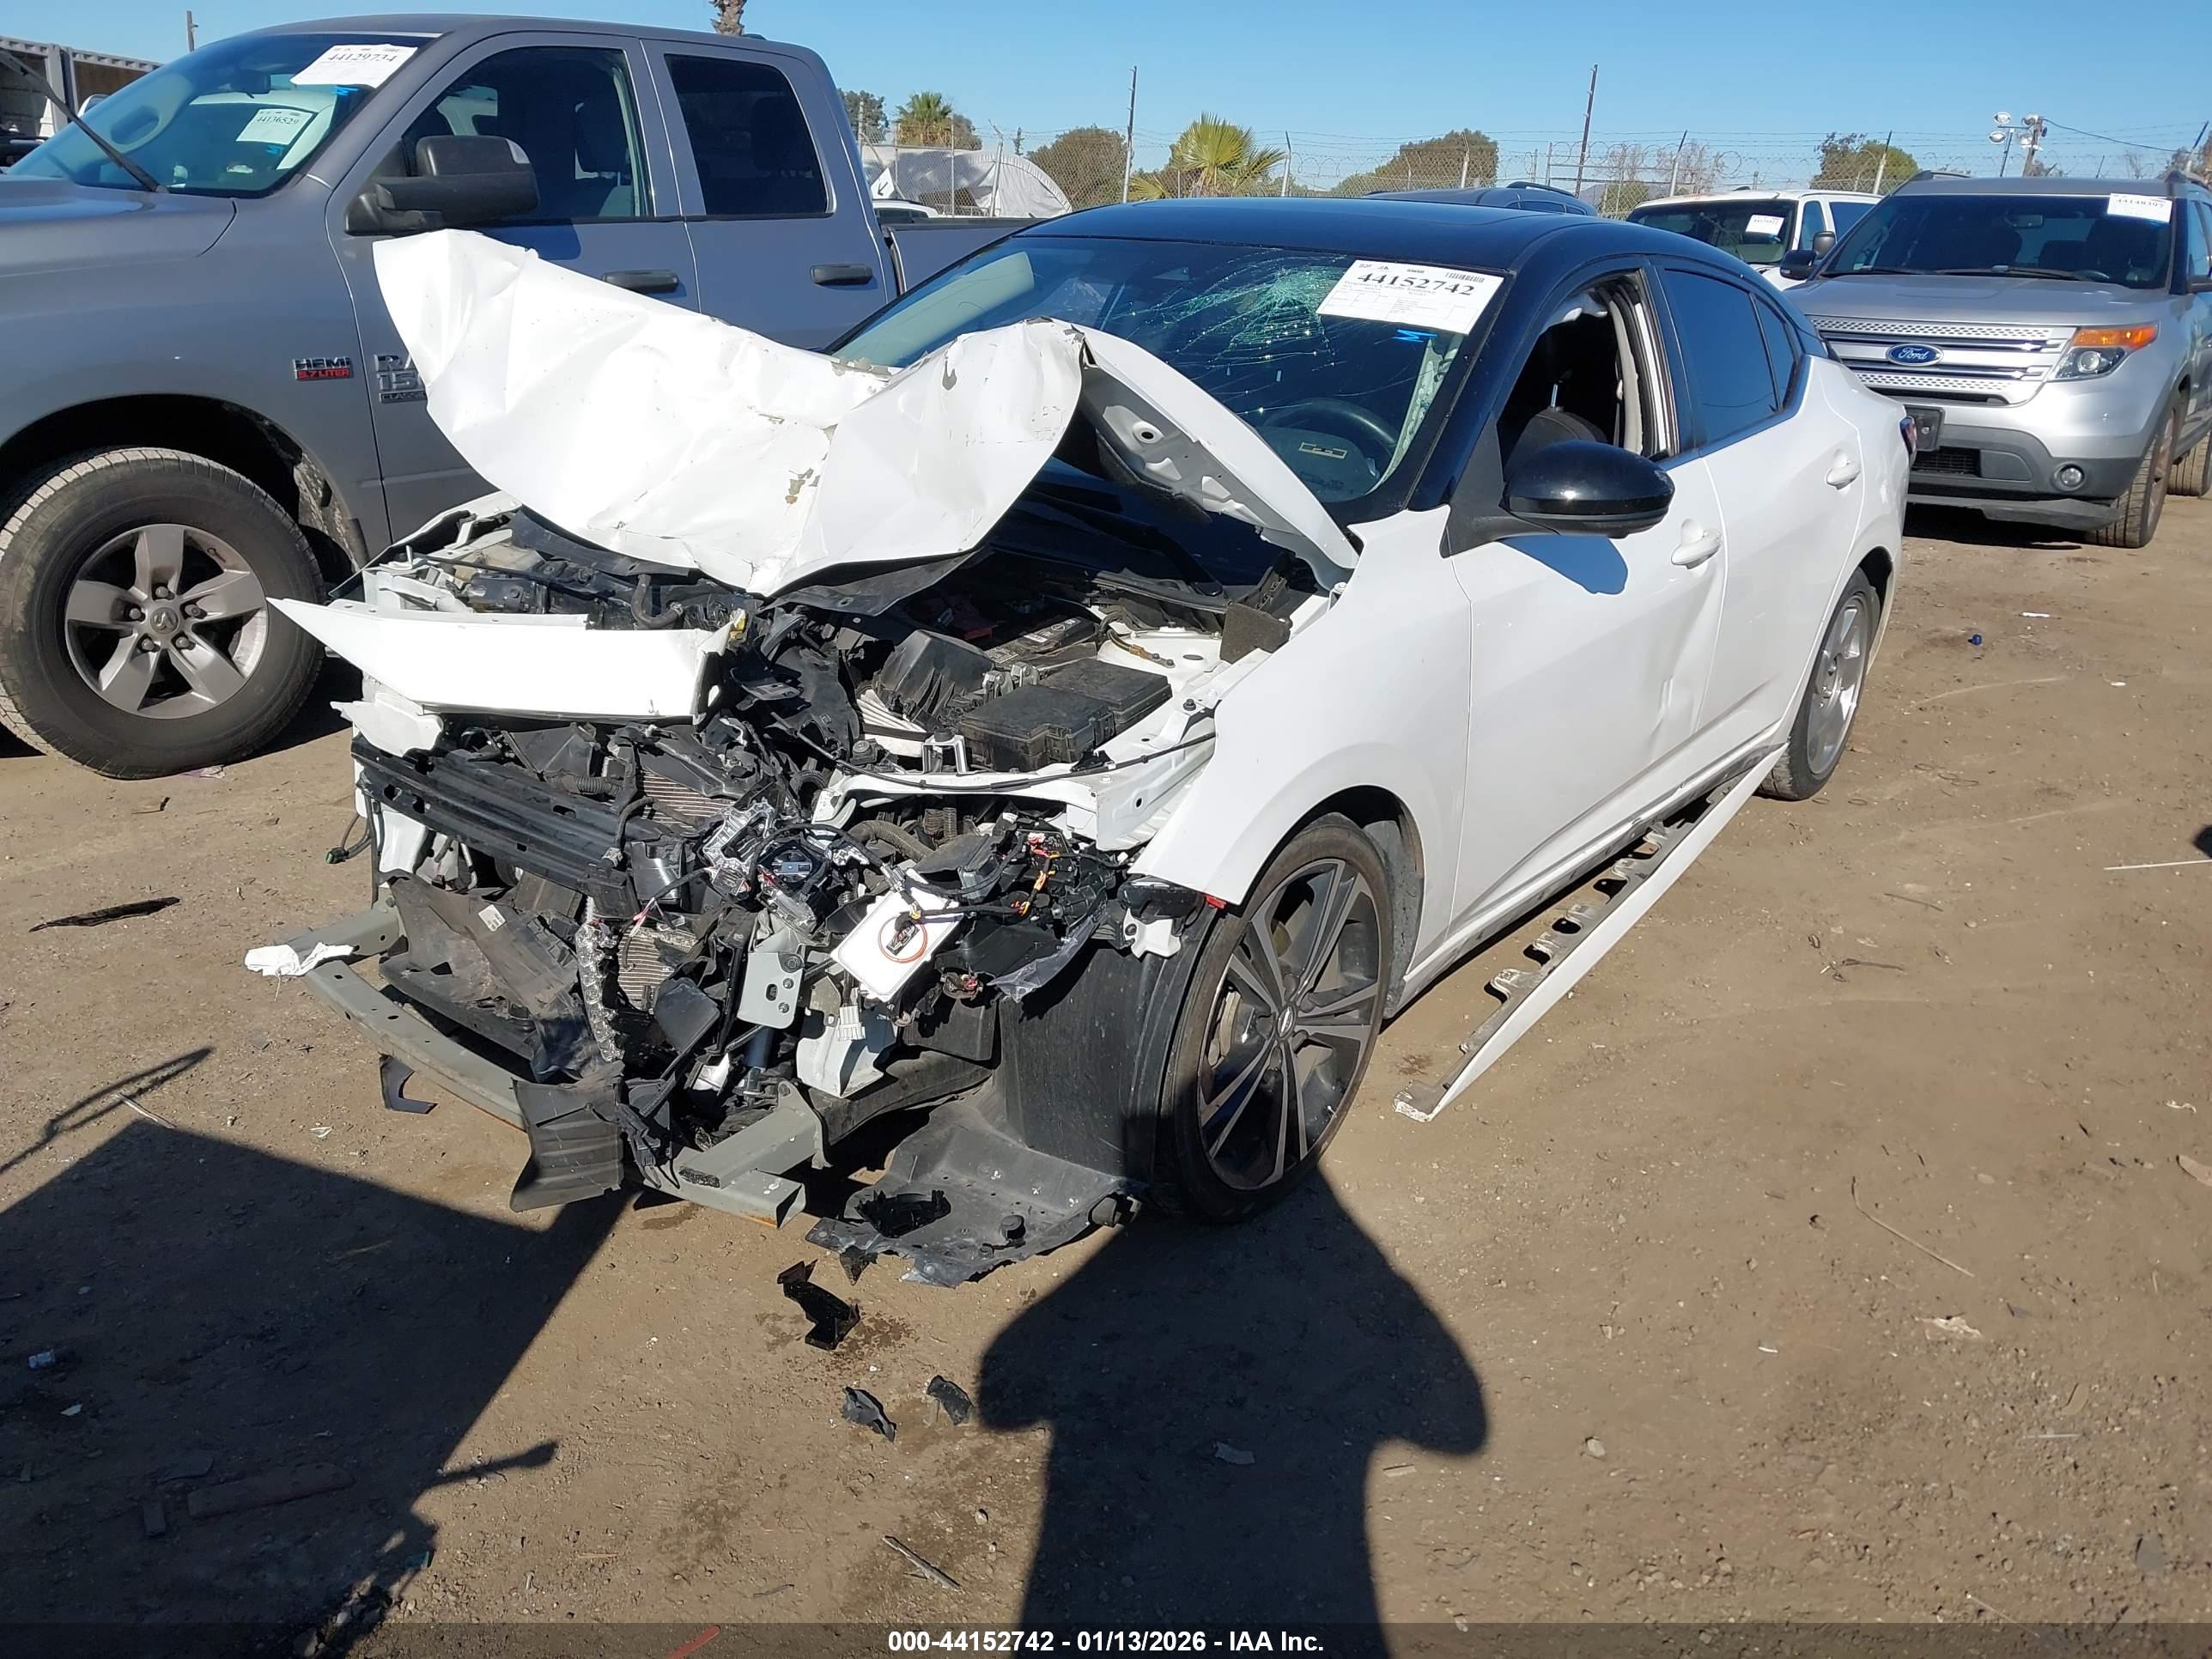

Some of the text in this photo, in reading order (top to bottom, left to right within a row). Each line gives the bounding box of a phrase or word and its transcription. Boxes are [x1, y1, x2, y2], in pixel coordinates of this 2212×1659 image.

[328, 53, 398, 63] 44129734
[1357, 272, 1475, 296] 44152742
[1898, 347, 1930, 360] Ford
[293, 357, 350, 369] HEMI
[319, 369, 350, 378] LITER
